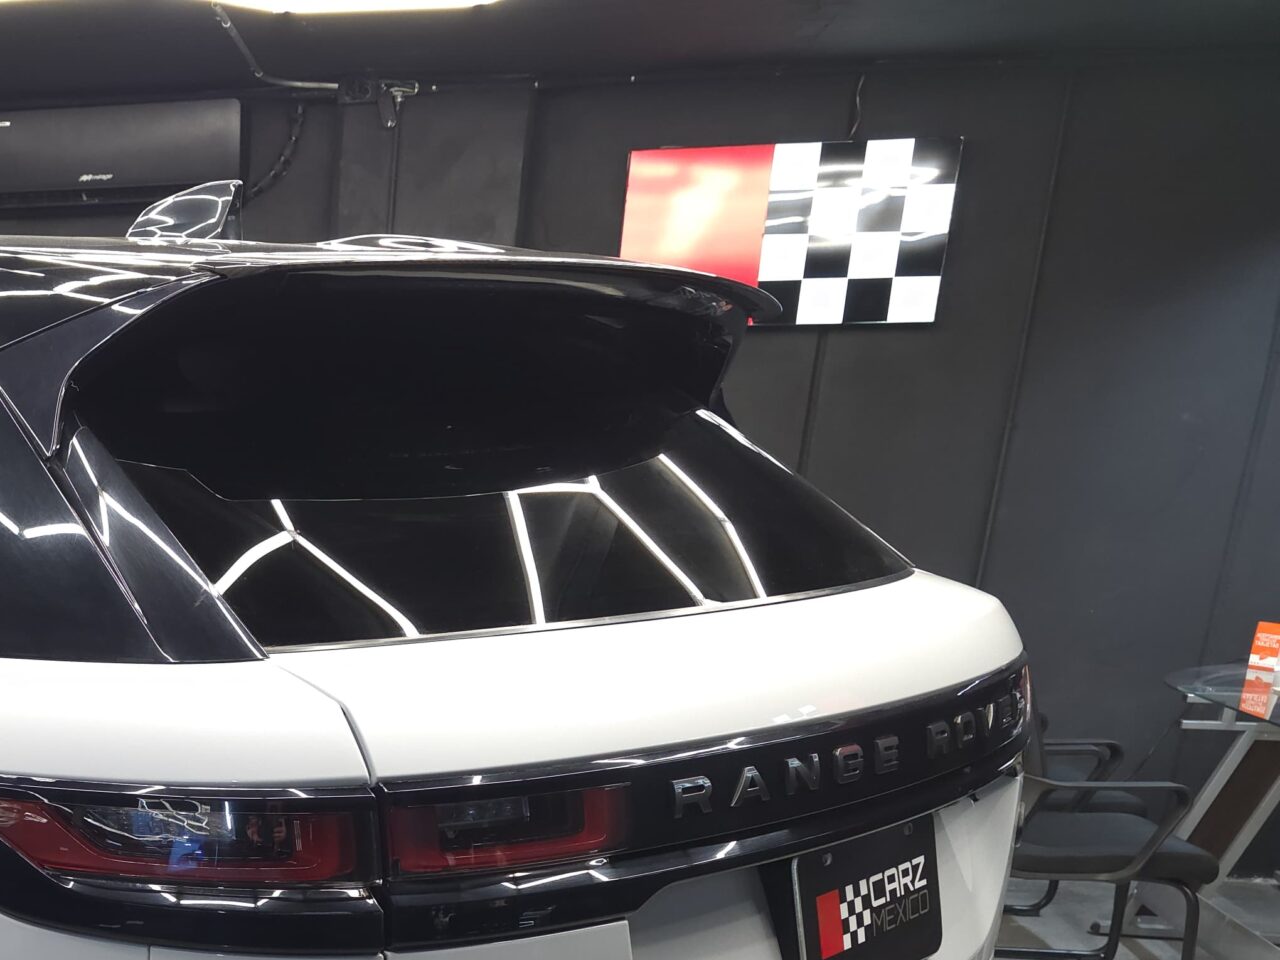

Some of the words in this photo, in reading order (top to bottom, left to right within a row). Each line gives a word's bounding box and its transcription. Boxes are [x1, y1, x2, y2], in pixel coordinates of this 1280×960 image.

[669, 734, 901, 820] RANGE
[869, 855, 928, 907] CARZ
[872, 889, 930, 937] MEXICO
